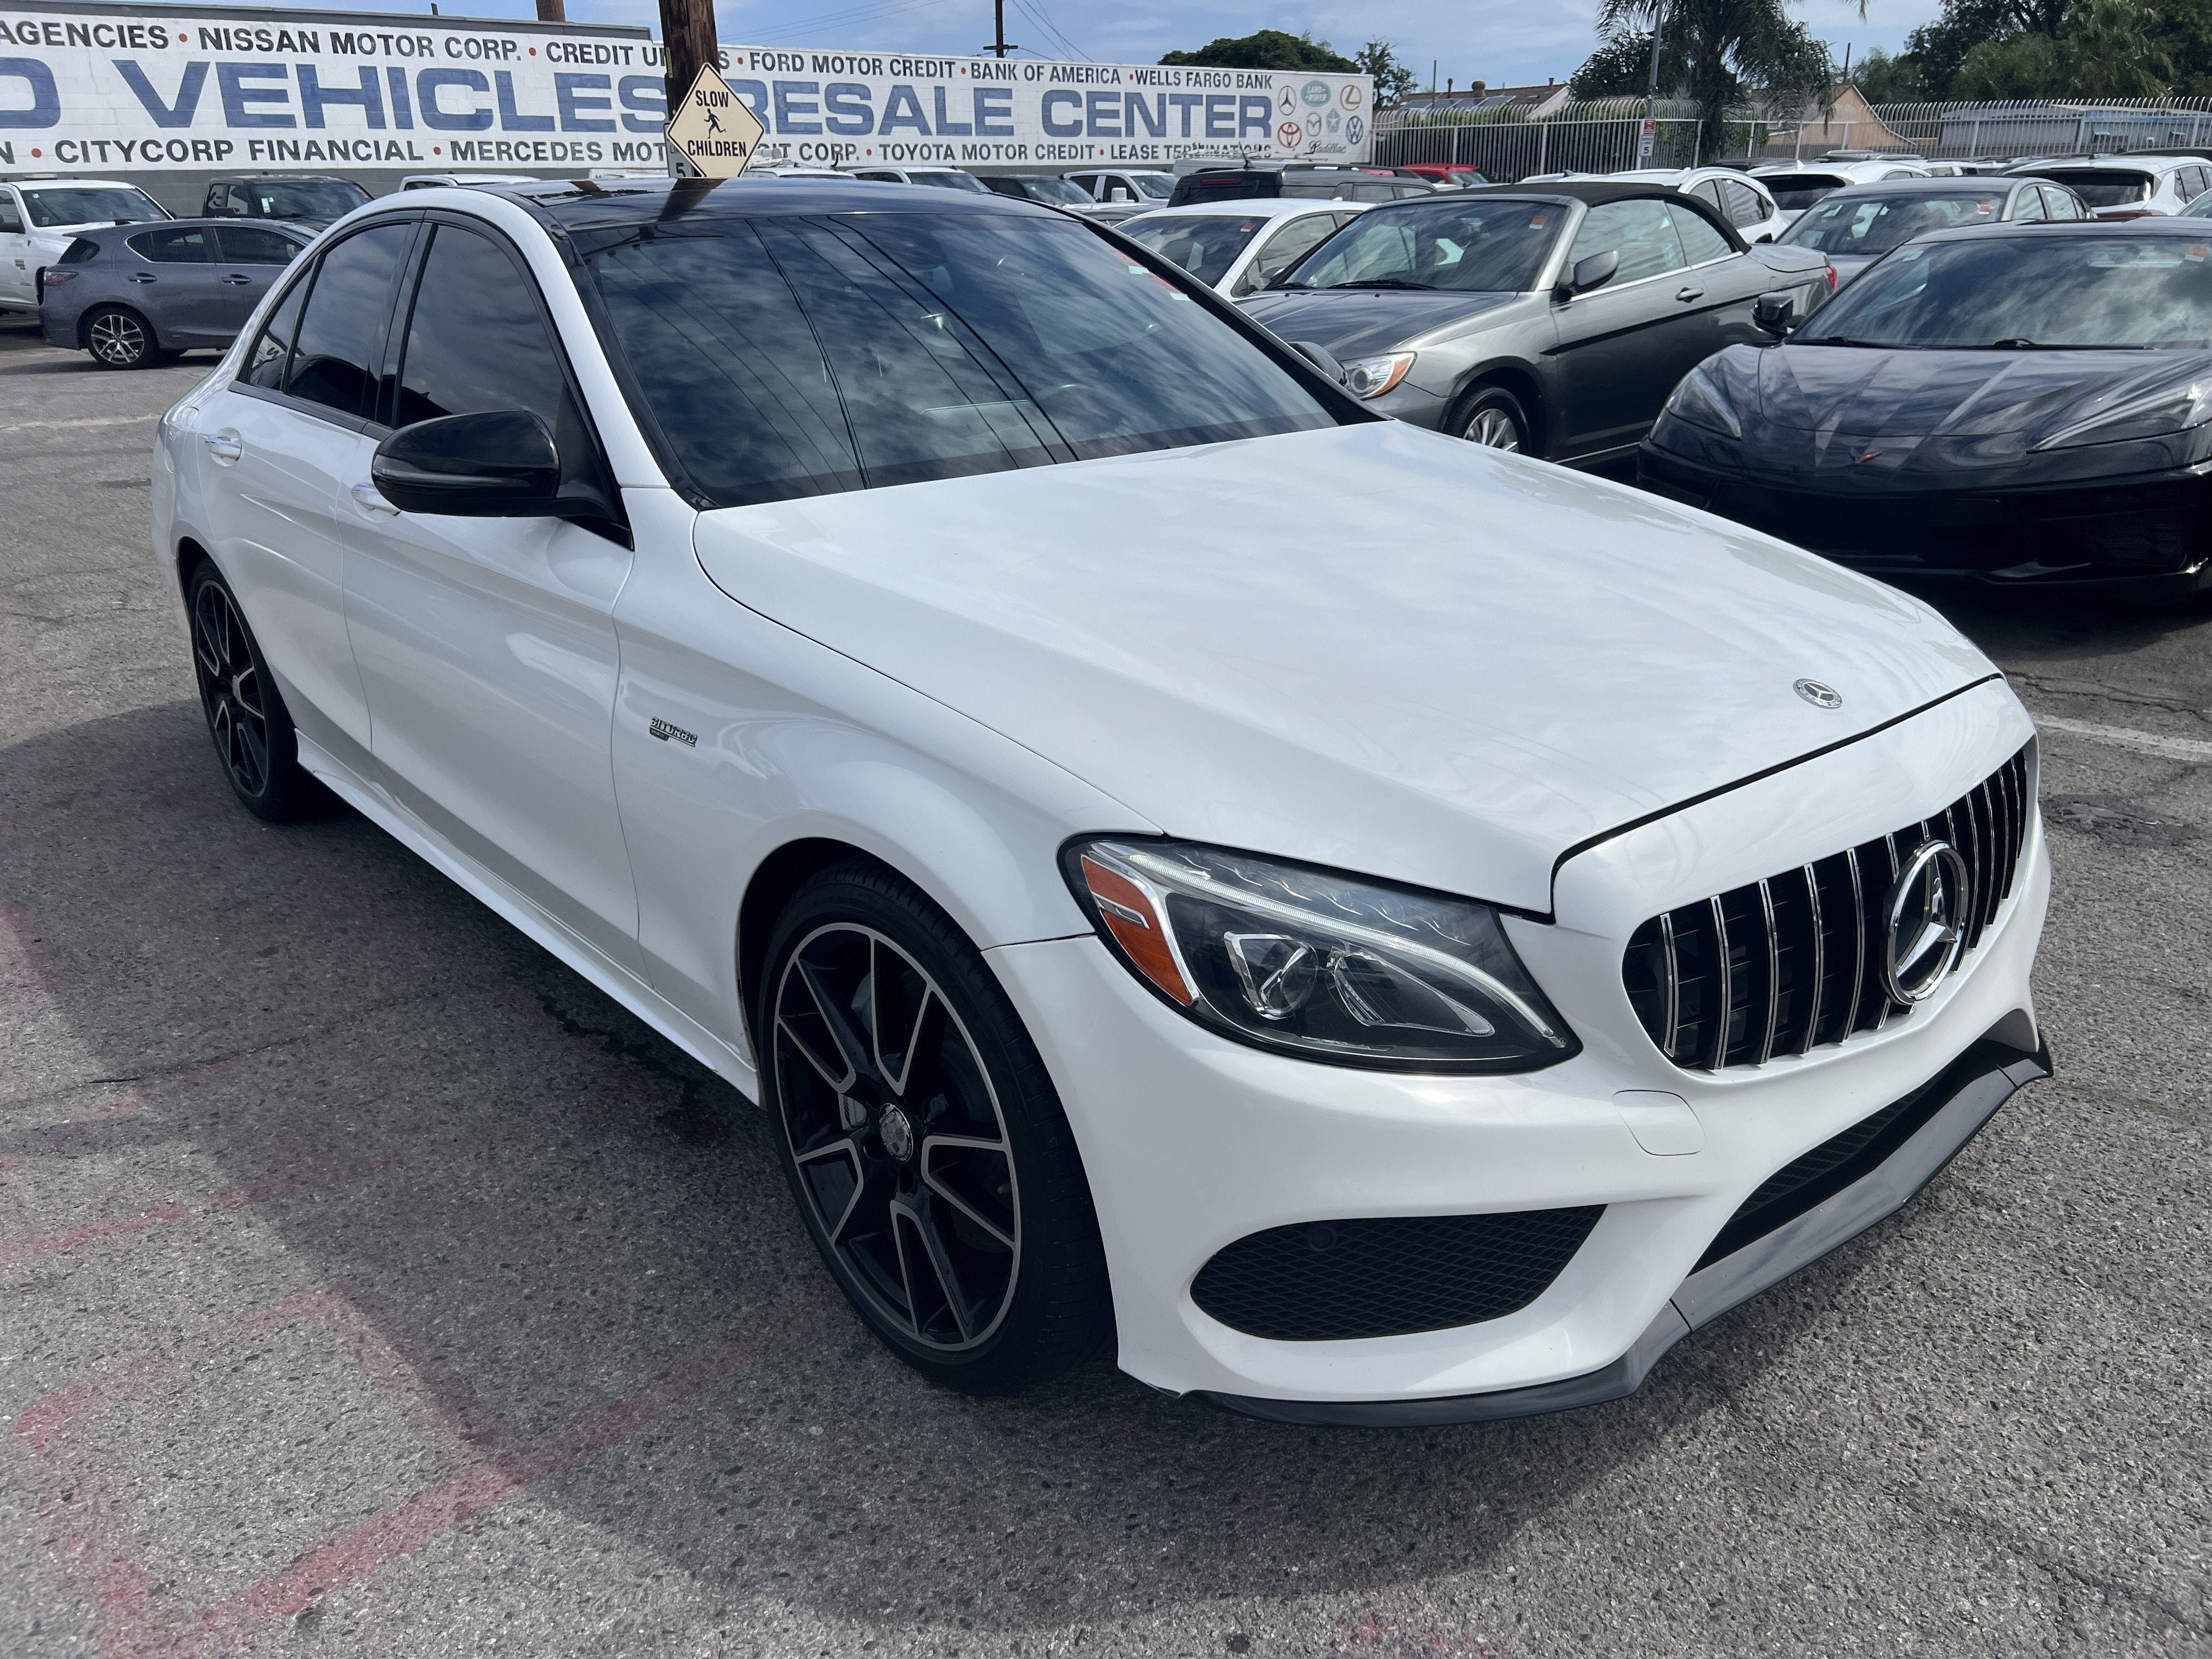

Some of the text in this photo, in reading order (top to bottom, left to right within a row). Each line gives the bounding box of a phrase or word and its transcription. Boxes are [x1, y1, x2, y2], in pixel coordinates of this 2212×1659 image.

[0, 21, 169, 49] AGENCIES
[199, 27, 321, 53] NISSAN
[330, 32, 435, 58] MOTOR
[445, 37, 521, 60] CORP.
[546, 42, 634, 65] CREDIT
[750, 52, 804, 71] FORD
[812, 55, 883, 75] MOTOR
[890, 59, 956, 78] CREDIT
[971, 63, 1018, 80] BANK
[1024, 65, 1045, 82] OF
[1049, 65, 1121, 84] AMERICA
[1135, 70, 1181, 87] WELLS
[1186, 71, 1232, 88] FARGO
[1237, 75, 1272, 89] BANK
[111, 59, 666, 133] VEHICLES
[1041, 89, 1272, 138] CENTER
[695, 90, 729, 108] SLOW
[55, 139, 234, 163] CITYCORP
[249, 140, 424, 161] FINANCIAL
[450, 141, 603, 161] MERCEDES
[613, 142, 666, 162] MOT
[799, 143, 860, 161] CORP.
[879, 144, 956, 160] TOYOTA
[962, 144, 1028, 160] MOTOR
[1035, 144, 1095, 160] CREDIT
[1111, 144, 1159, 160] LEASE
[687, 140, 747, 157] CHILDREN
[651, 716, 698, 744] BITURBO
